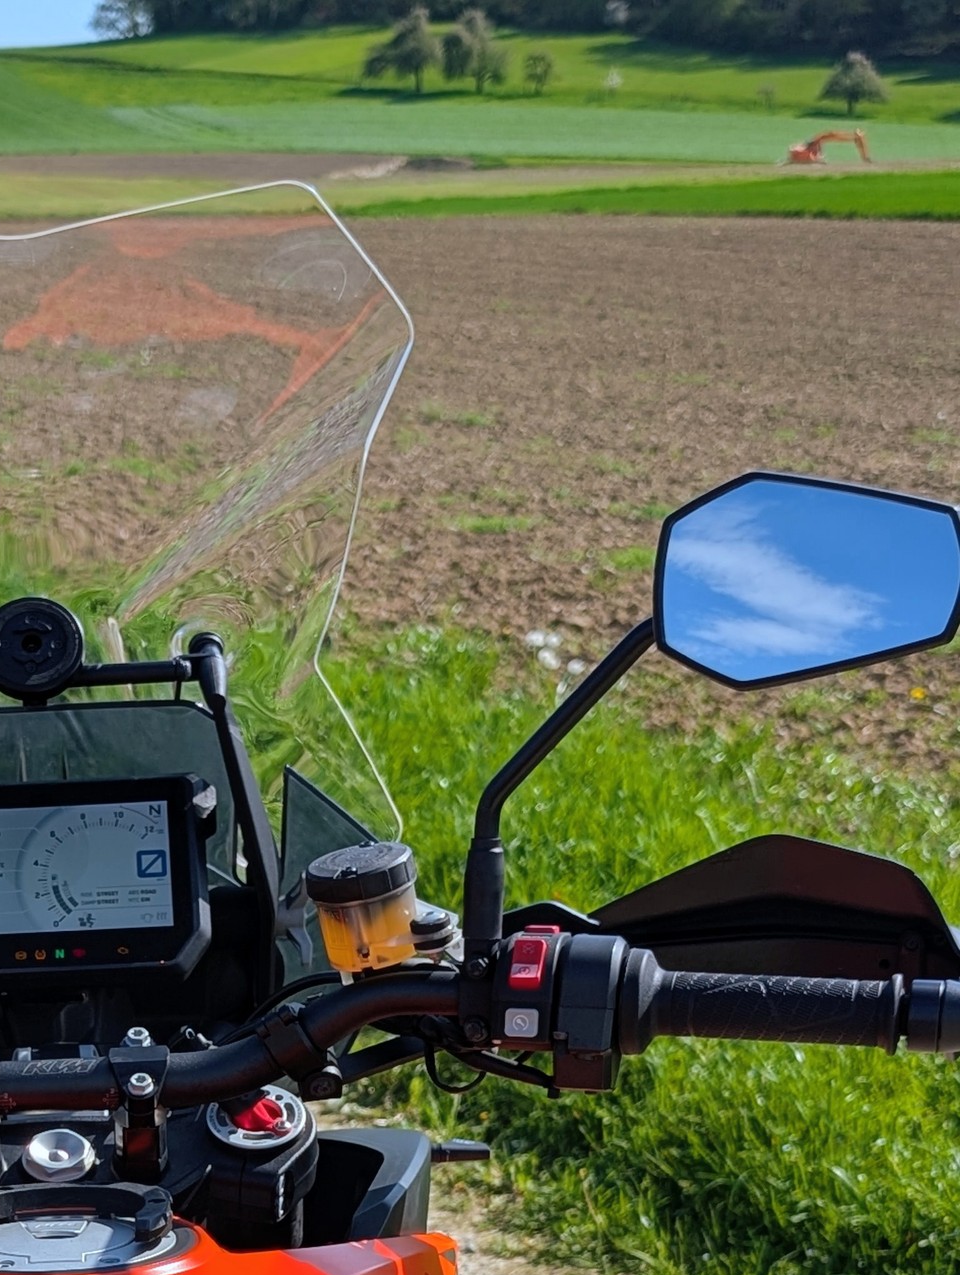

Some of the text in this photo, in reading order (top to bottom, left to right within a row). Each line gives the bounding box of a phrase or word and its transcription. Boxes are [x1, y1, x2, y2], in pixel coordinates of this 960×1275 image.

[148, 804, 161, 816] N
[113, 811, 124, 819] 10
[144, 825, 155, 833] 12
[53, 920, 60, 928] 0
[22, 1058, 97, 1076] KTM
